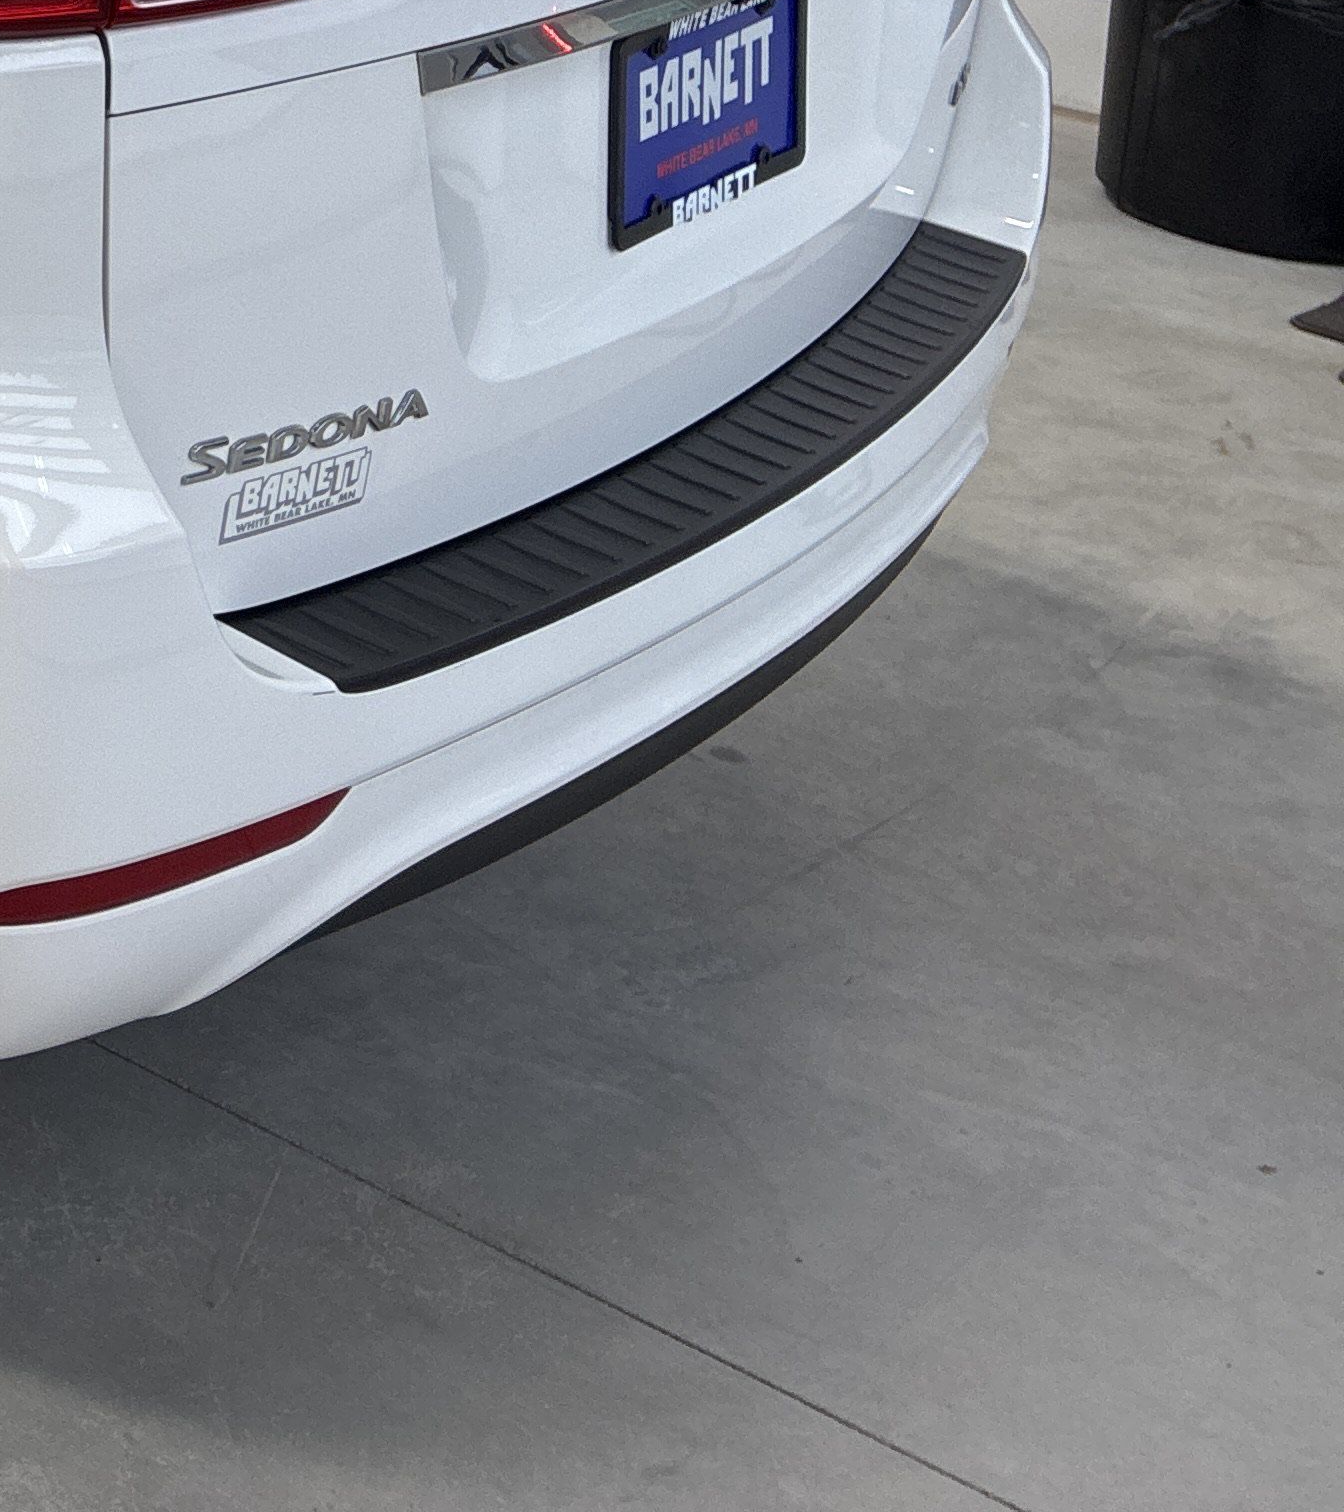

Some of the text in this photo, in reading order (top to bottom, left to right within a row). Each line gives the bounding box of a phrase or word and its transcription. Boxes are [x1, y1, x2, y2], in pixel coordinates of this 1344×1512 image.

[668, 8, 709, 41] WHITE
[708, 1, 739, 26] BEAR
[639, 15, 774, 143] BARNETT
[657, 150, 688, 179] WHITE
[672, 162, 757, 226] BARNETT
[180, 388, 429, 486] SEDONA
[235, 516, 270, 534] WHITE
[274, 506, 301, 522] BEAR
[338, 489, 356, 503] MN
[238, 450, 367, 518] BARNETT
